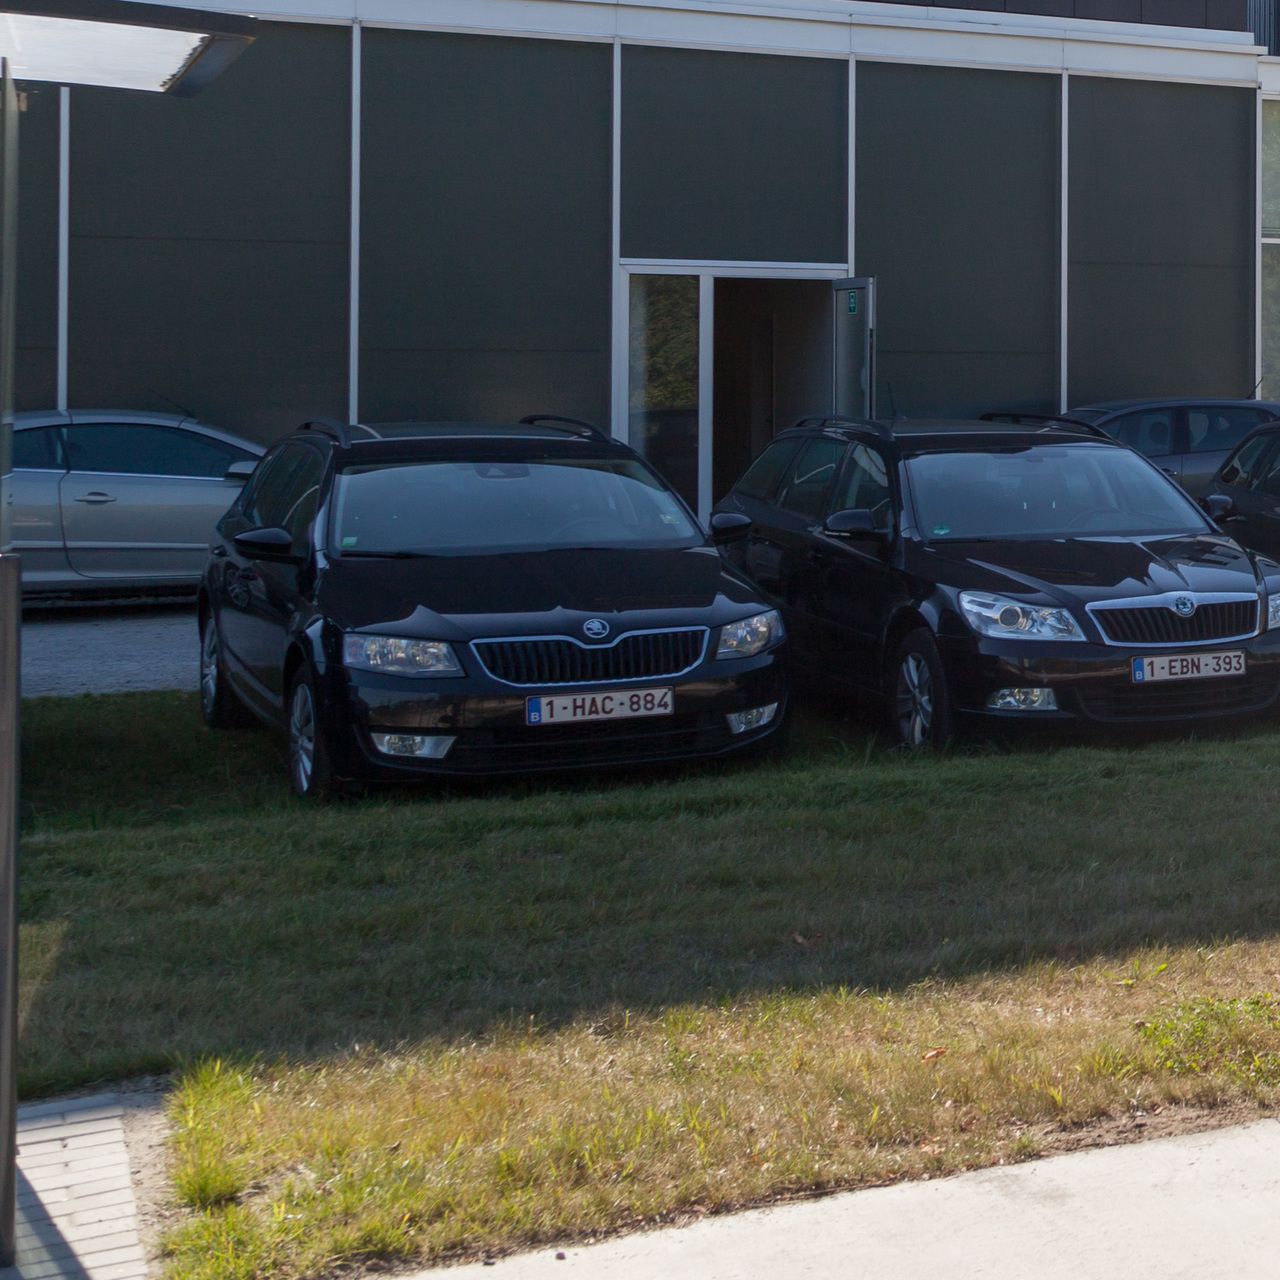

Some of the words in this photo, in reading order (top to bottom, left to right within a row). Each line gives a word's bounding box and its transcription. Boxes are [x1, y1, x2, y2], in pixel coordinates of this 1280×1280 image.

[1146, 654, 1244, 678] 1-EBN-393
[530, 712, 541, 723] B
[544, 692, 671, 720] 1-HAC-884
